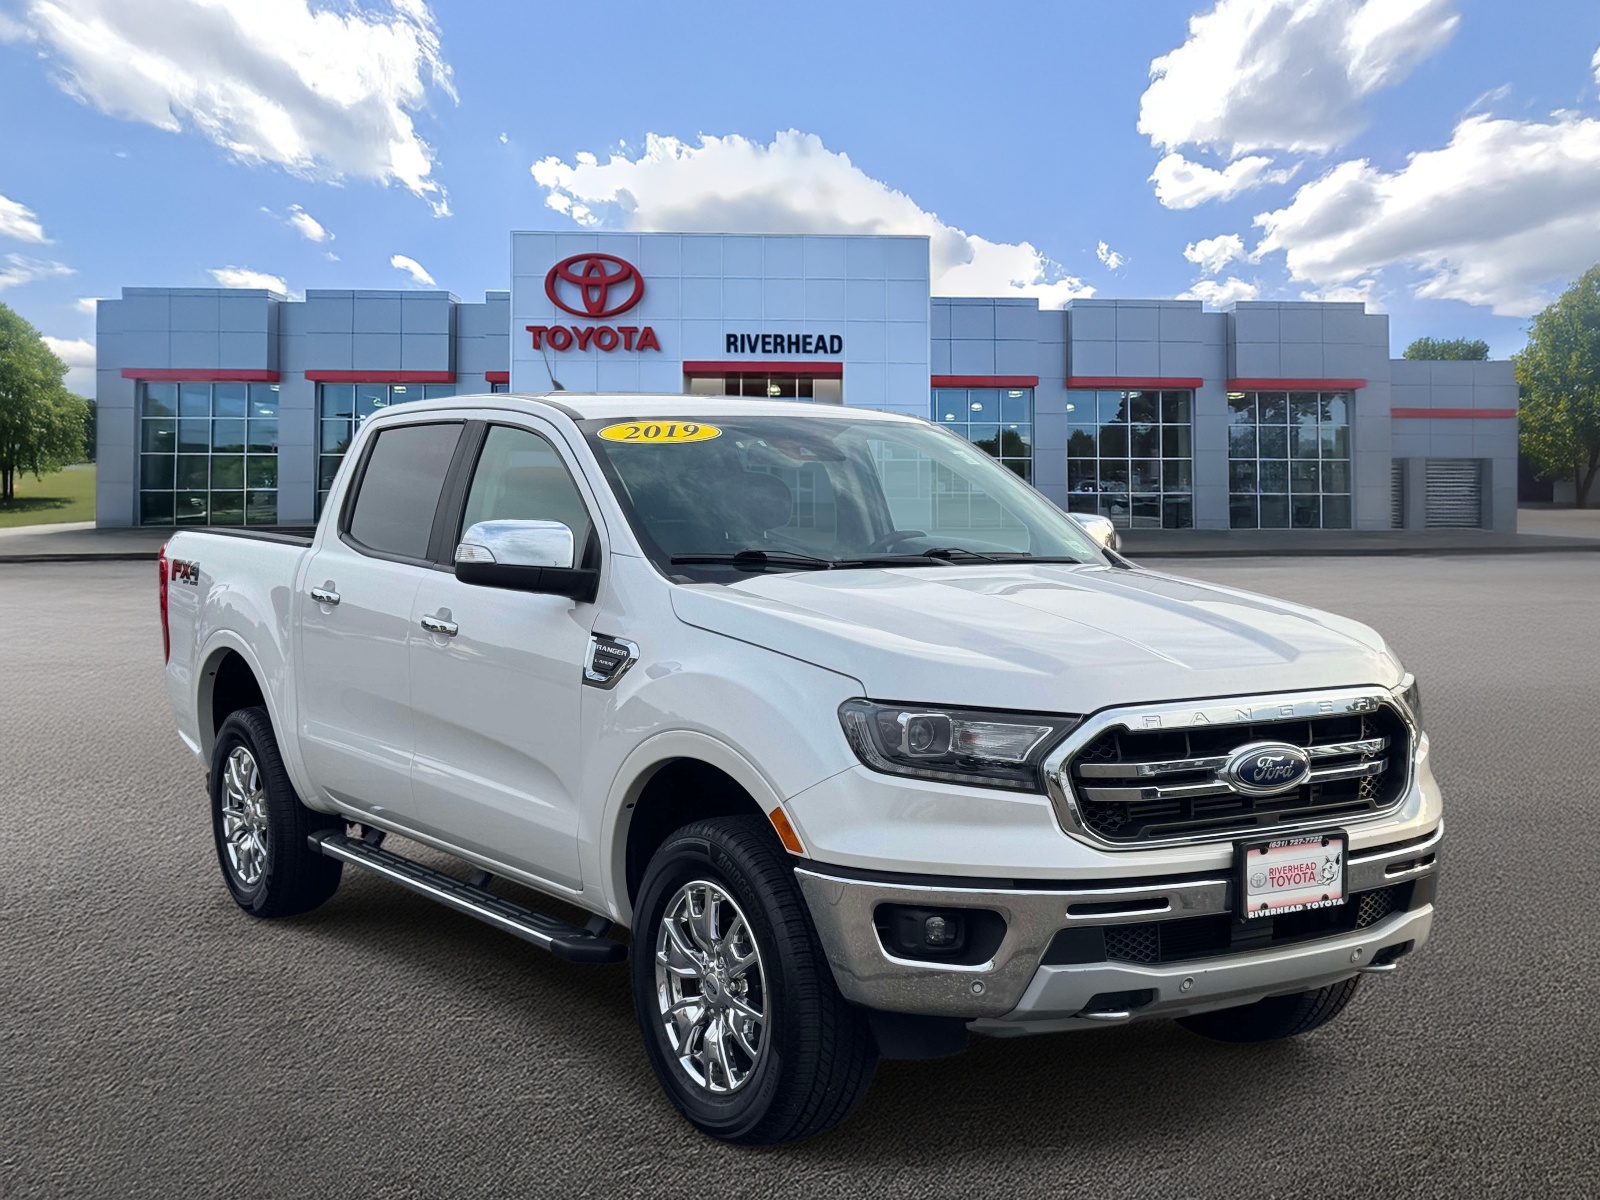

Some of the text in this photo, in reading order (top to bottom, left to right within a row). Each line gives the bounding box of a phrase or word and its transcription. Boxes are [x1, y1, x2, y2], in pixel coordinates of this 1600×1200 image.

[526, 325, 661, 352] TOYOTA
[726, 333, 844, 354] RIVERHEAD
[623, 424, 699, 439] 2019
[171, 559, 200, 581] FX4
[596, 644, 628, 657] RANGER
[1141, 698, 1375, 730] RANGER
[1254, 755, 1295, 780] Ford
[1269, 840, 1288, 848] (631)
[1268, 862, 1317, 876] RIVERHEAD
[1269, 871, 1316, 888] TOYOTA
[1248, 898, 1344, 919] RIVERHEAD TOYOTA
